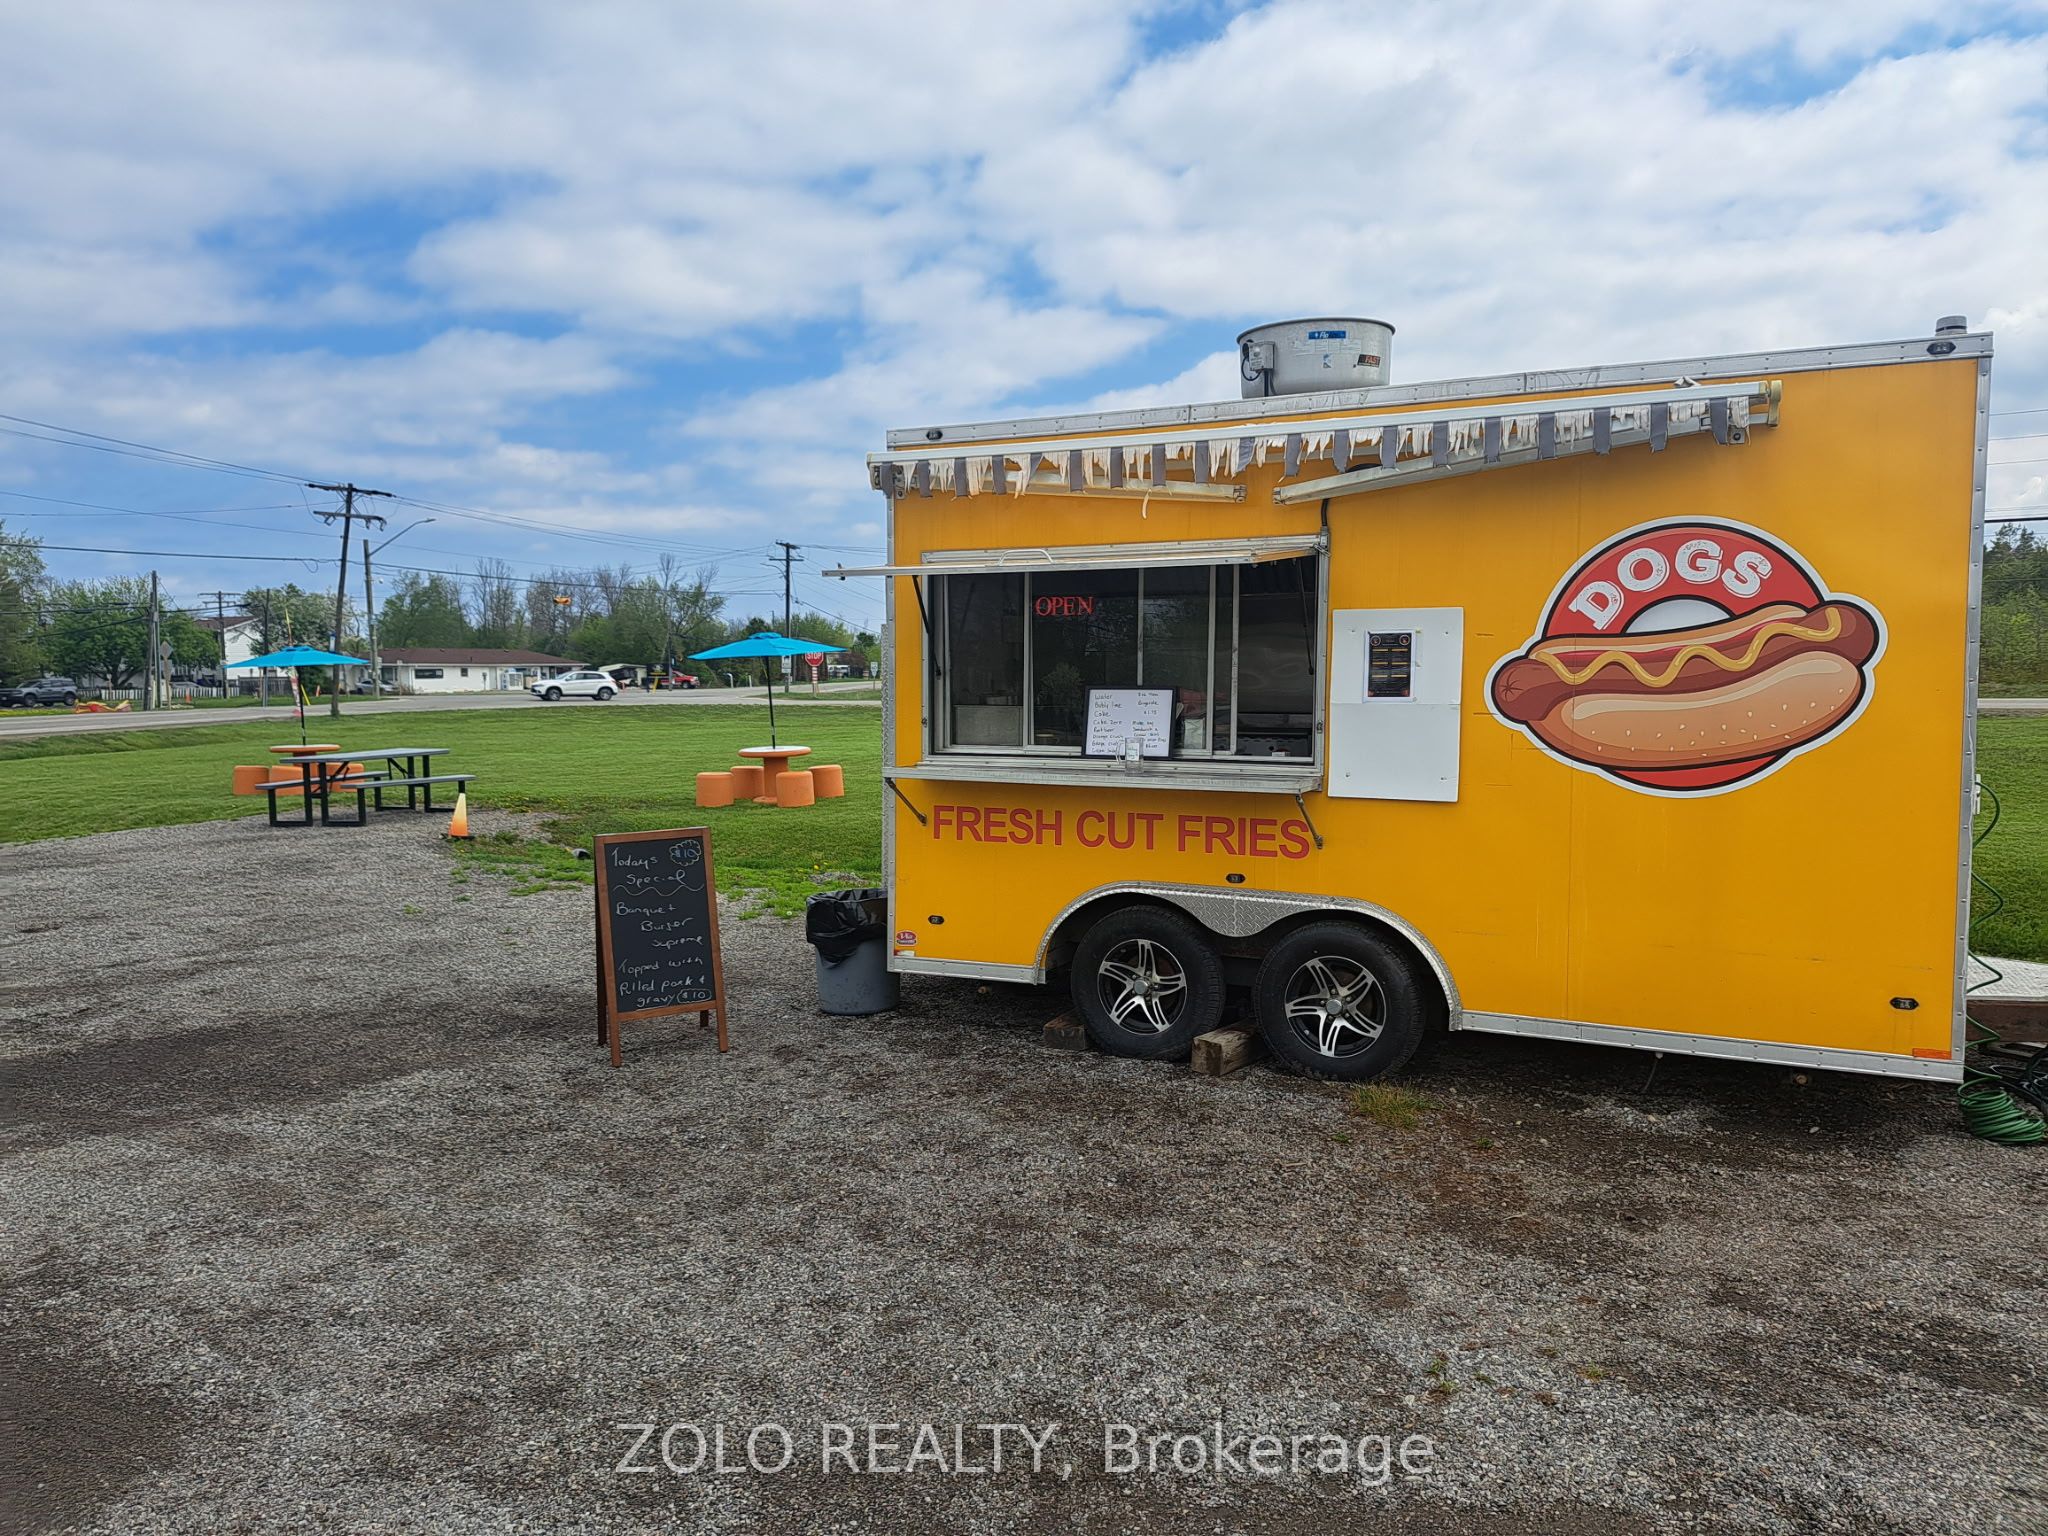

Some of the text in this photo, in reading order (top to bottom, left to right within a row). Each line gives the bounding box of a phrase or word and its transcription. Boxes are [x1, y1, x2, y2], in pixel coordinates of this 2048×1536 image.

[1568, 539, 1772, 630] DOGS
[1035, 596, 1095, 617] OPEN
[1094, 710, 1111, 718] Coke
[933, 805, 1311, 860] FRESH CUT FRIES
[611, 846, 696, 870] Todays $10
[626, 869, 686, 888] Special
[616, 901, 677, 917] Banquet
[640, 917, 695, 932] Burger
[668, 956, 703, 969] with
[637, 991, 707, 1008] gravy $10
